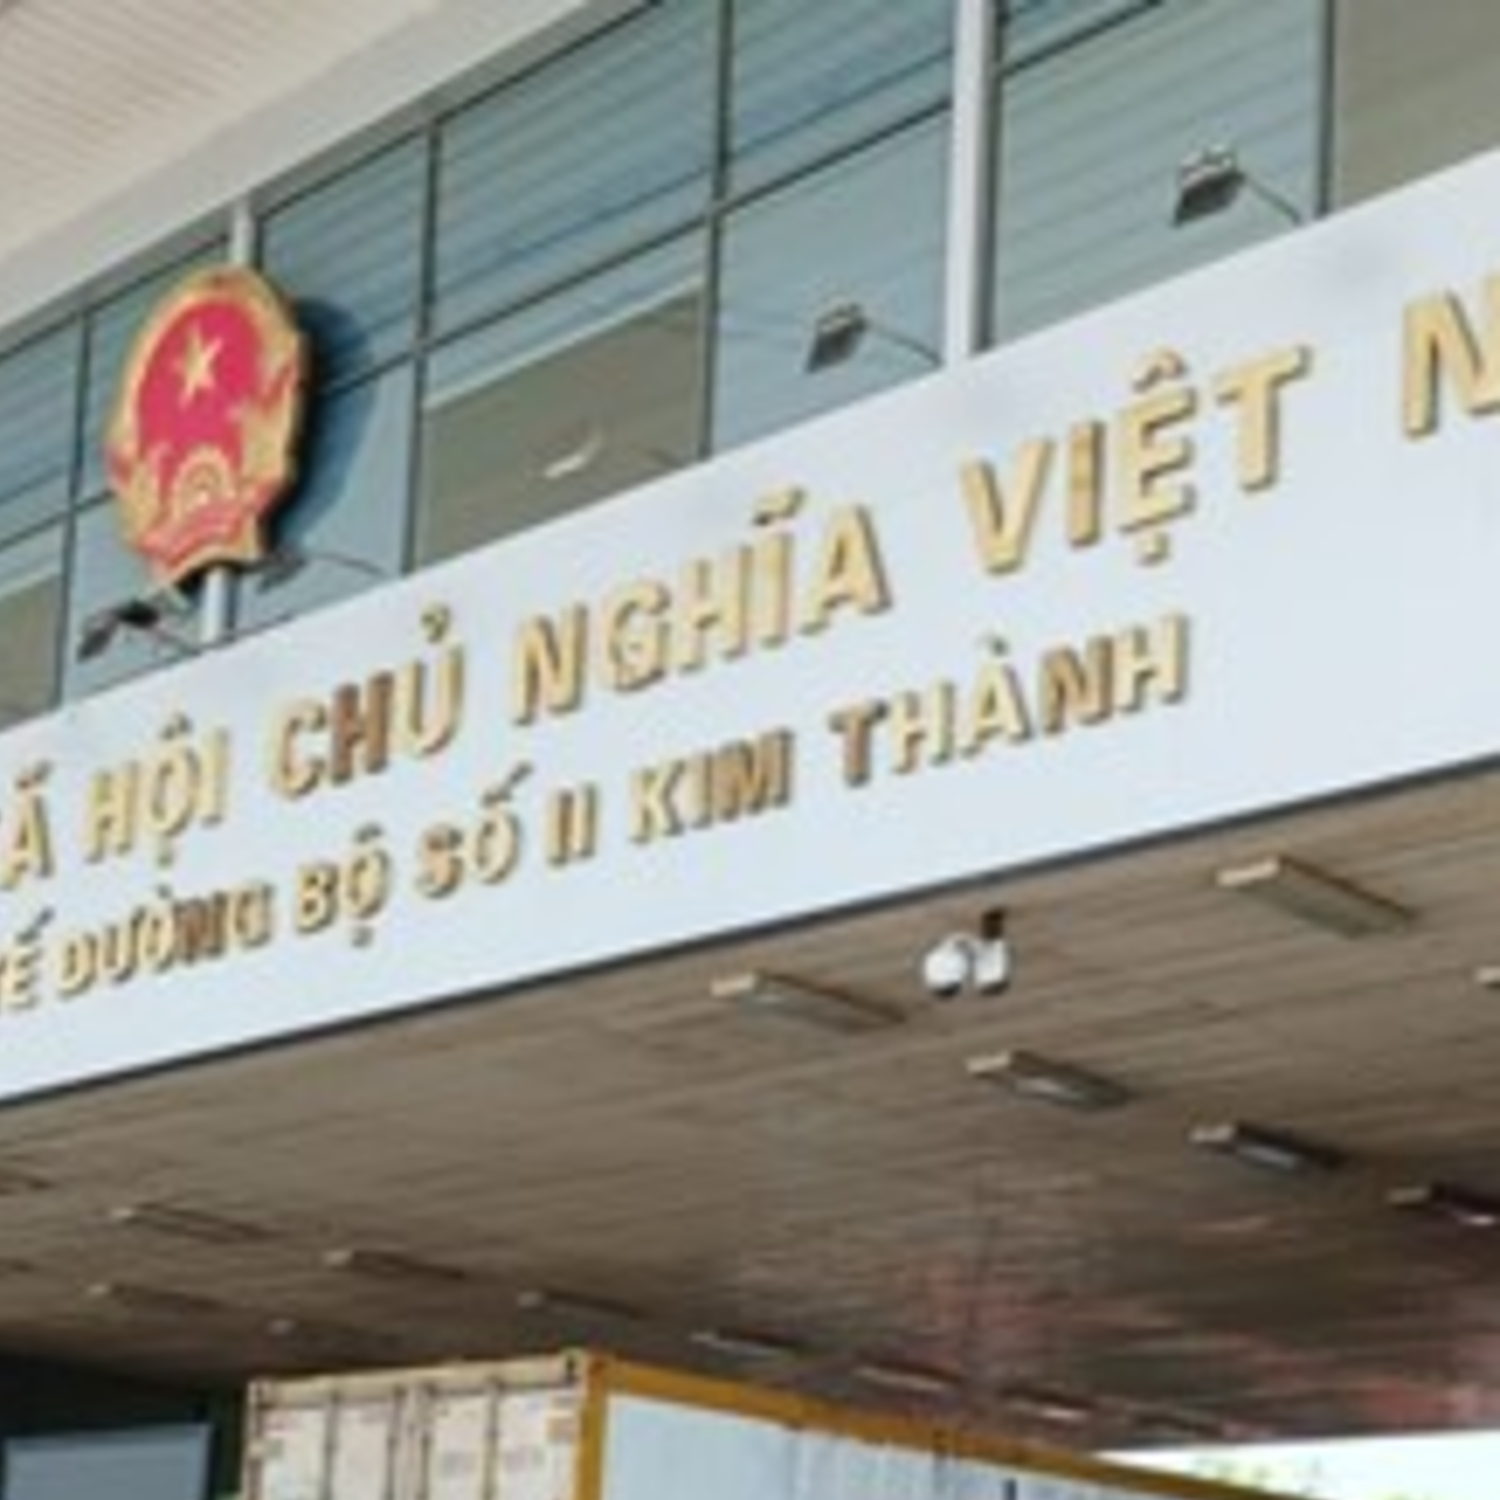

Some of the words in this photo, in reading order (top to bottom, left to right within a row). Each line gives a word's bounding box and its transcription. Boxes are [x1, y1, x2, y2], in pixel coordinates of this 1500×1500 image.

[83, 712, 232, 869] HỘI
[270, 603, 465, 800] CHỦ
[510, 487, 894, 727] NGHĨA
[958, 344, 1313, 576] VIỆT
[294, 823, 390, 947] BỘ
[414, 762, 533, 899] SỐ
[546, 783, 598, 868] II
[627, 727, 796, 846] KIM
[827, 610, 1192, 788] THÀNH
